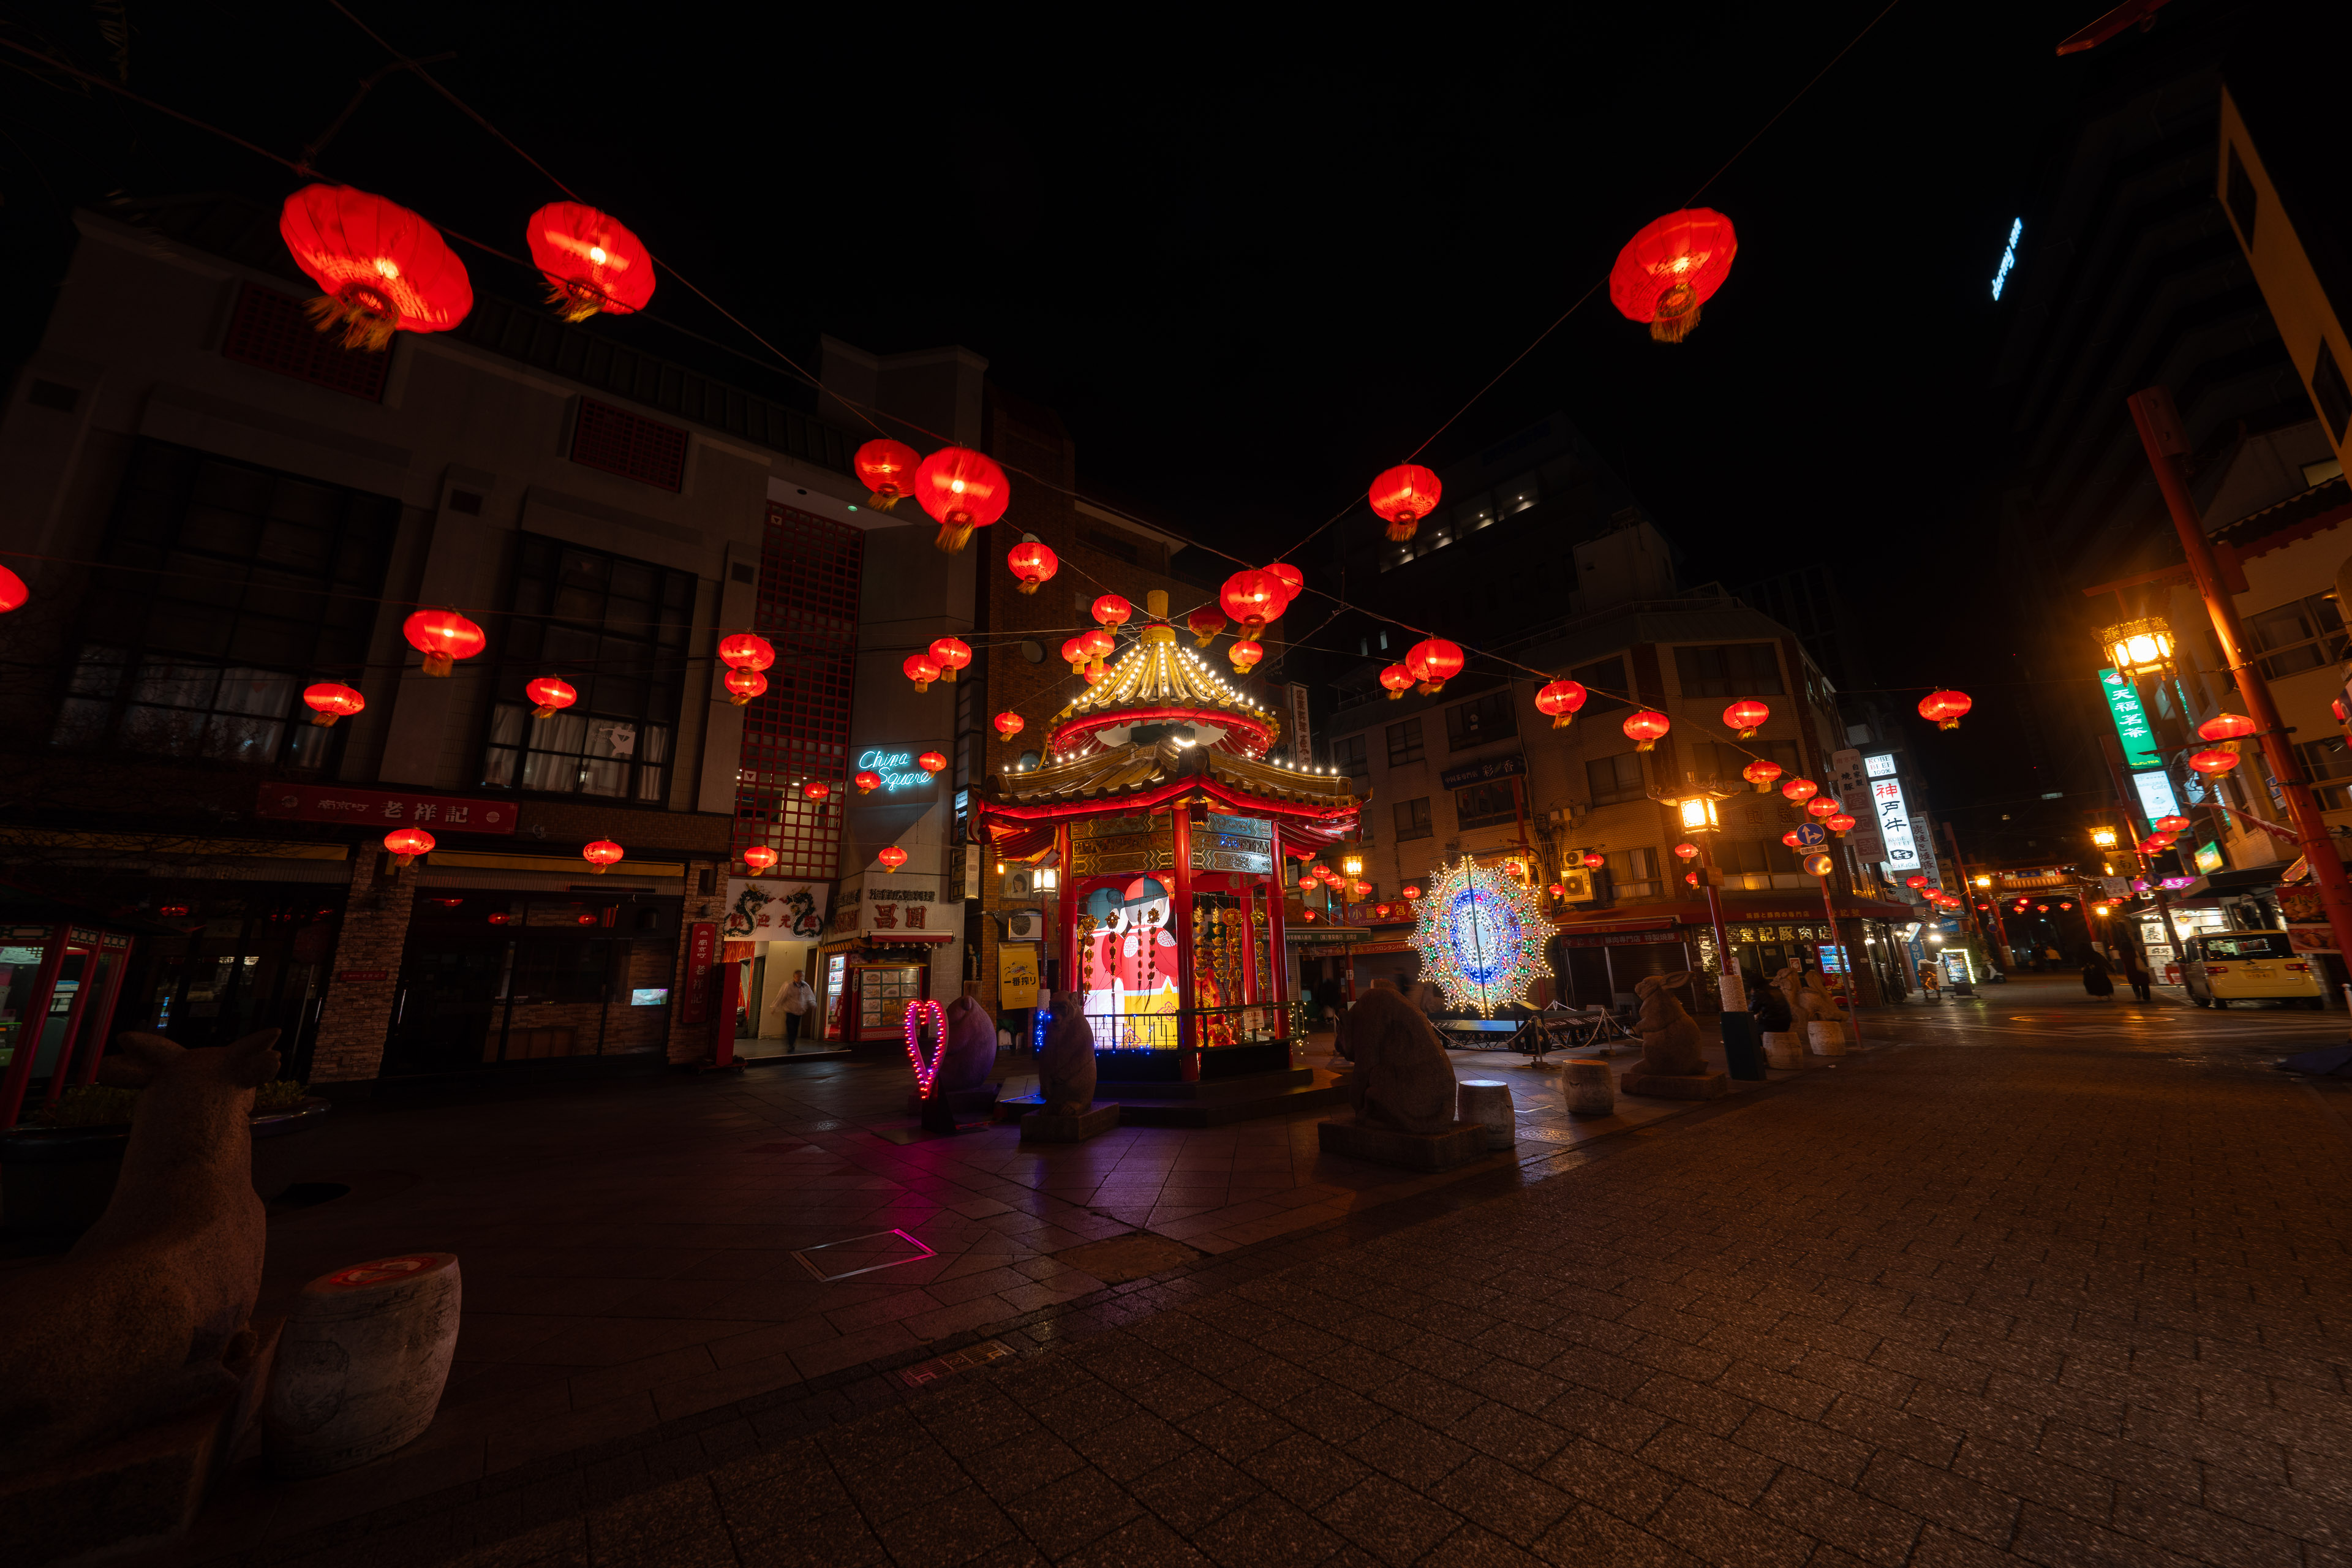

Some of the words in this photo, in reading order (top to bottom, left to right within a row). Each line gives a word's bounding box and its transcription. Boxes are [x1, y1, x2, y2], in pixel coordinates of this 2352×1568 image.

[2111, 688, 2148, 738] 天福茗茶
[859, 750, 908, 769] China
[1482, 760, 1514, 778] 彩香
[1868, 755, 1891, 764] KOBE
[1870, 761, 1891, 771] BEEF
[878, 766, 932, 791] Square
[1852, 763, 1864, 787] 自家製
[317, 799, 370, 813] 南京町
[379, 800, 469, 824] 老祥記
[1875, 783, 1907, 832] 神戸牛
[1352, 904, 1406, 920] 小籠包
[1740, 925, 1833, 943] 堂記豚肉店
[697, 939, 708, 959] 南京町
[690, 965, 706, 1005] 老祥記
[1004, 976, 1036, 986] 一番搾り
